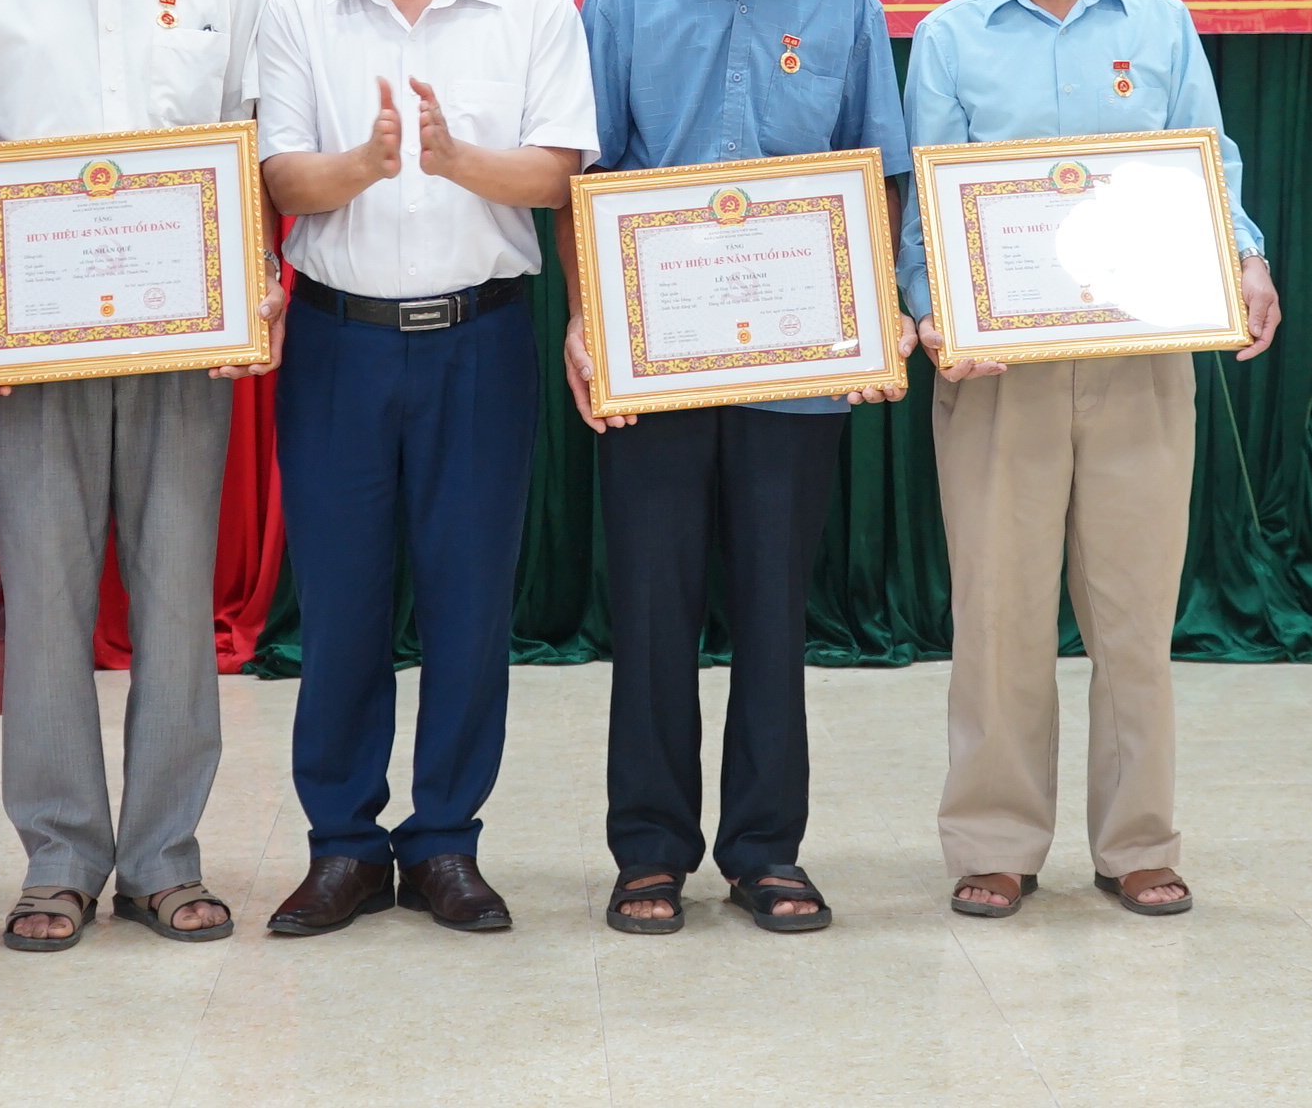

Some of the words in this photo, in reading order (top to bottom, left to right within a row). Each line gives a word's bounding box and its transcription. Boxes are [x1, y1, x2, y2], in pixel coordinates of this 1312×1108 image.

[26, 232, 49, 243] HUY
[52, 229, 79, 241] HIỆU
[94, 226, 119, 236] NĂM
[150, 221, 181, 232] ĐẢNG
[1002, 225, 1025, 234] HUY
[660, 260, 683, 271] HUY
[685, 256, 712, 270] HIỆU
[714, 257, 725, 265] 45
[726, 253, 751, 264] NĂM
[782, 247, 812, 259] ĐẢNG
